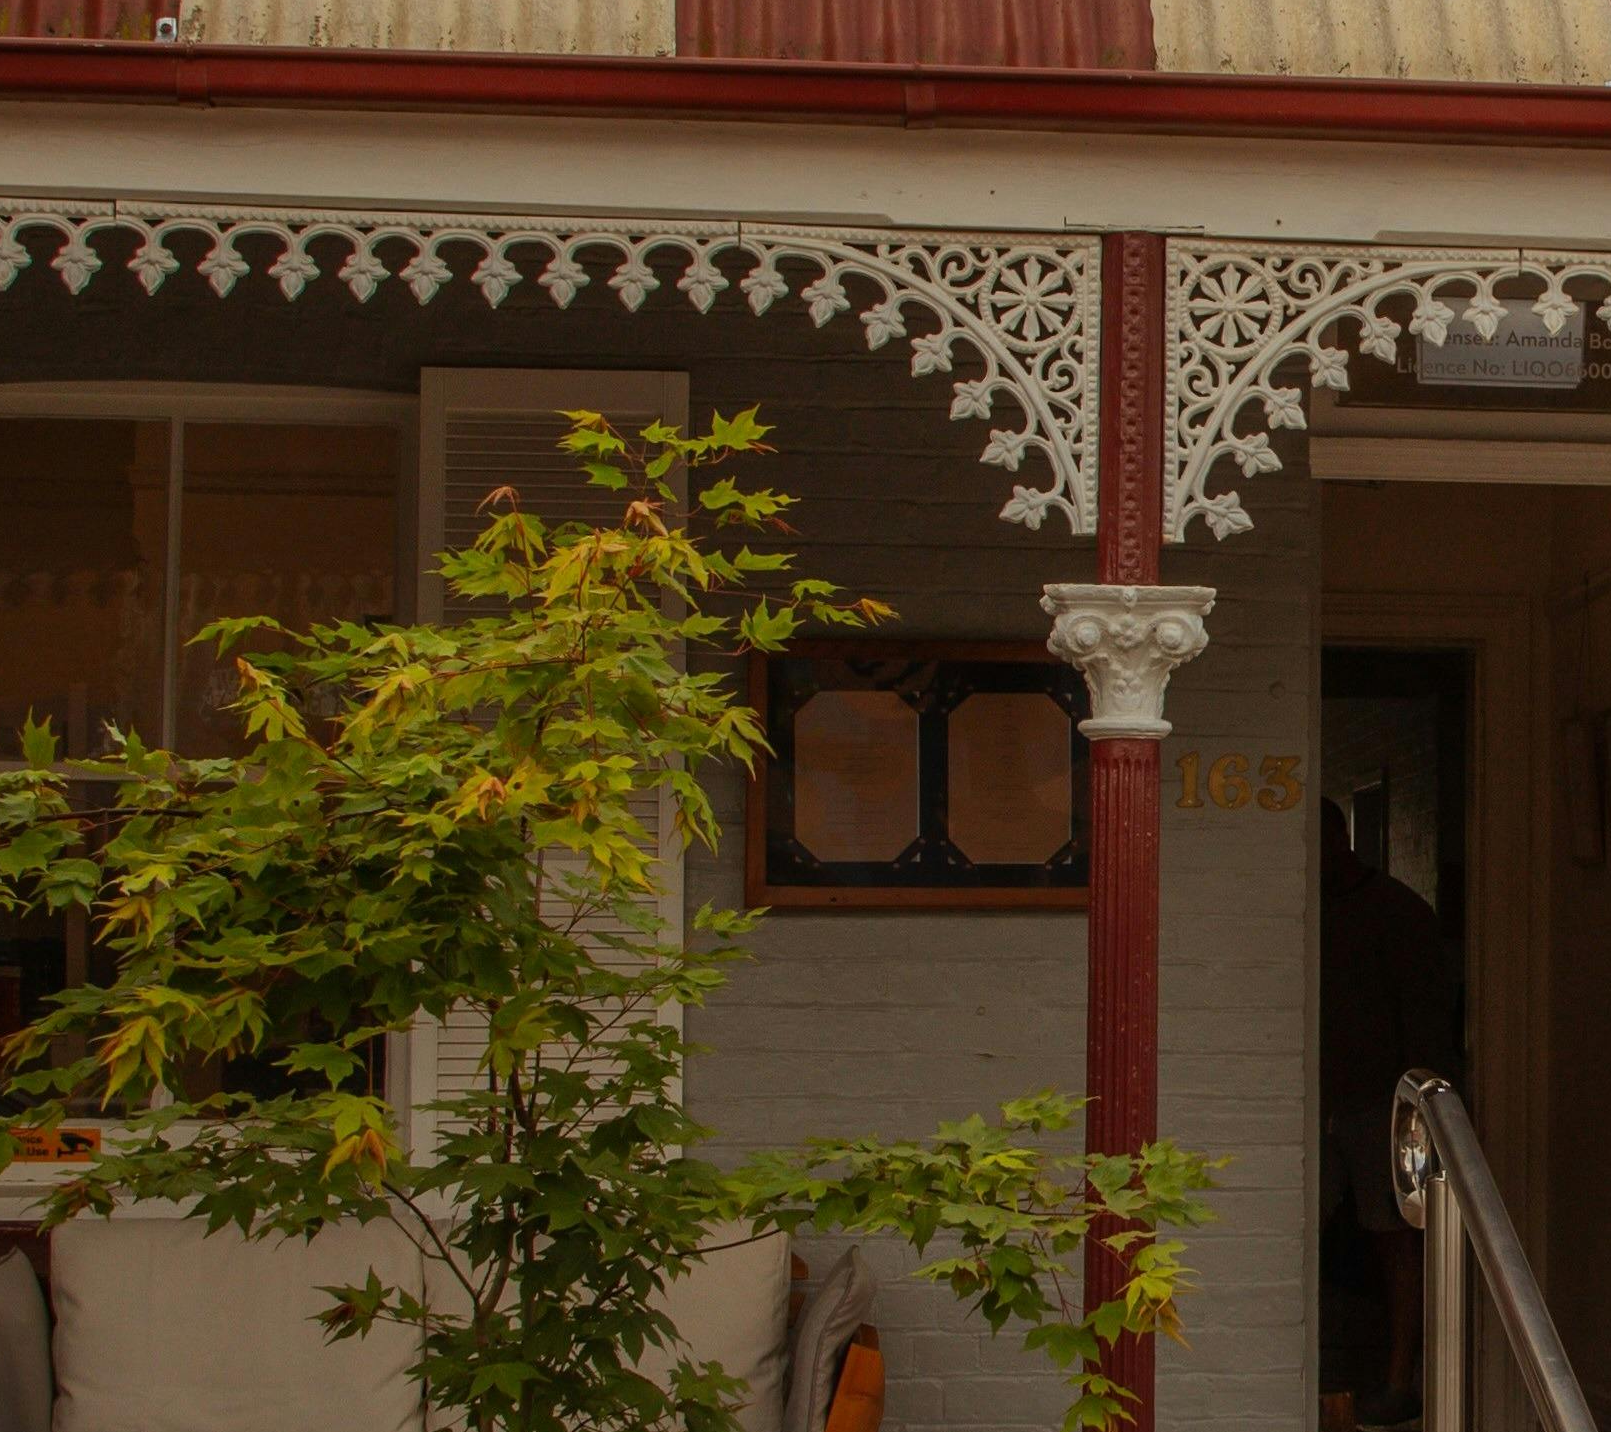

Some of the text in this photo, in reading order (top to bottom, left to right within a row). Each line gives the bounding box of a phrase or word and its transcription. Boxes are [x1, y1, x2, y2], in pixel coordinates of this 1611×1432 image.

[1505, 329, 1582, 349] Amanda
[1473, 358, 1506, 376] No:
[1175, 750, 1304, 812] 163
